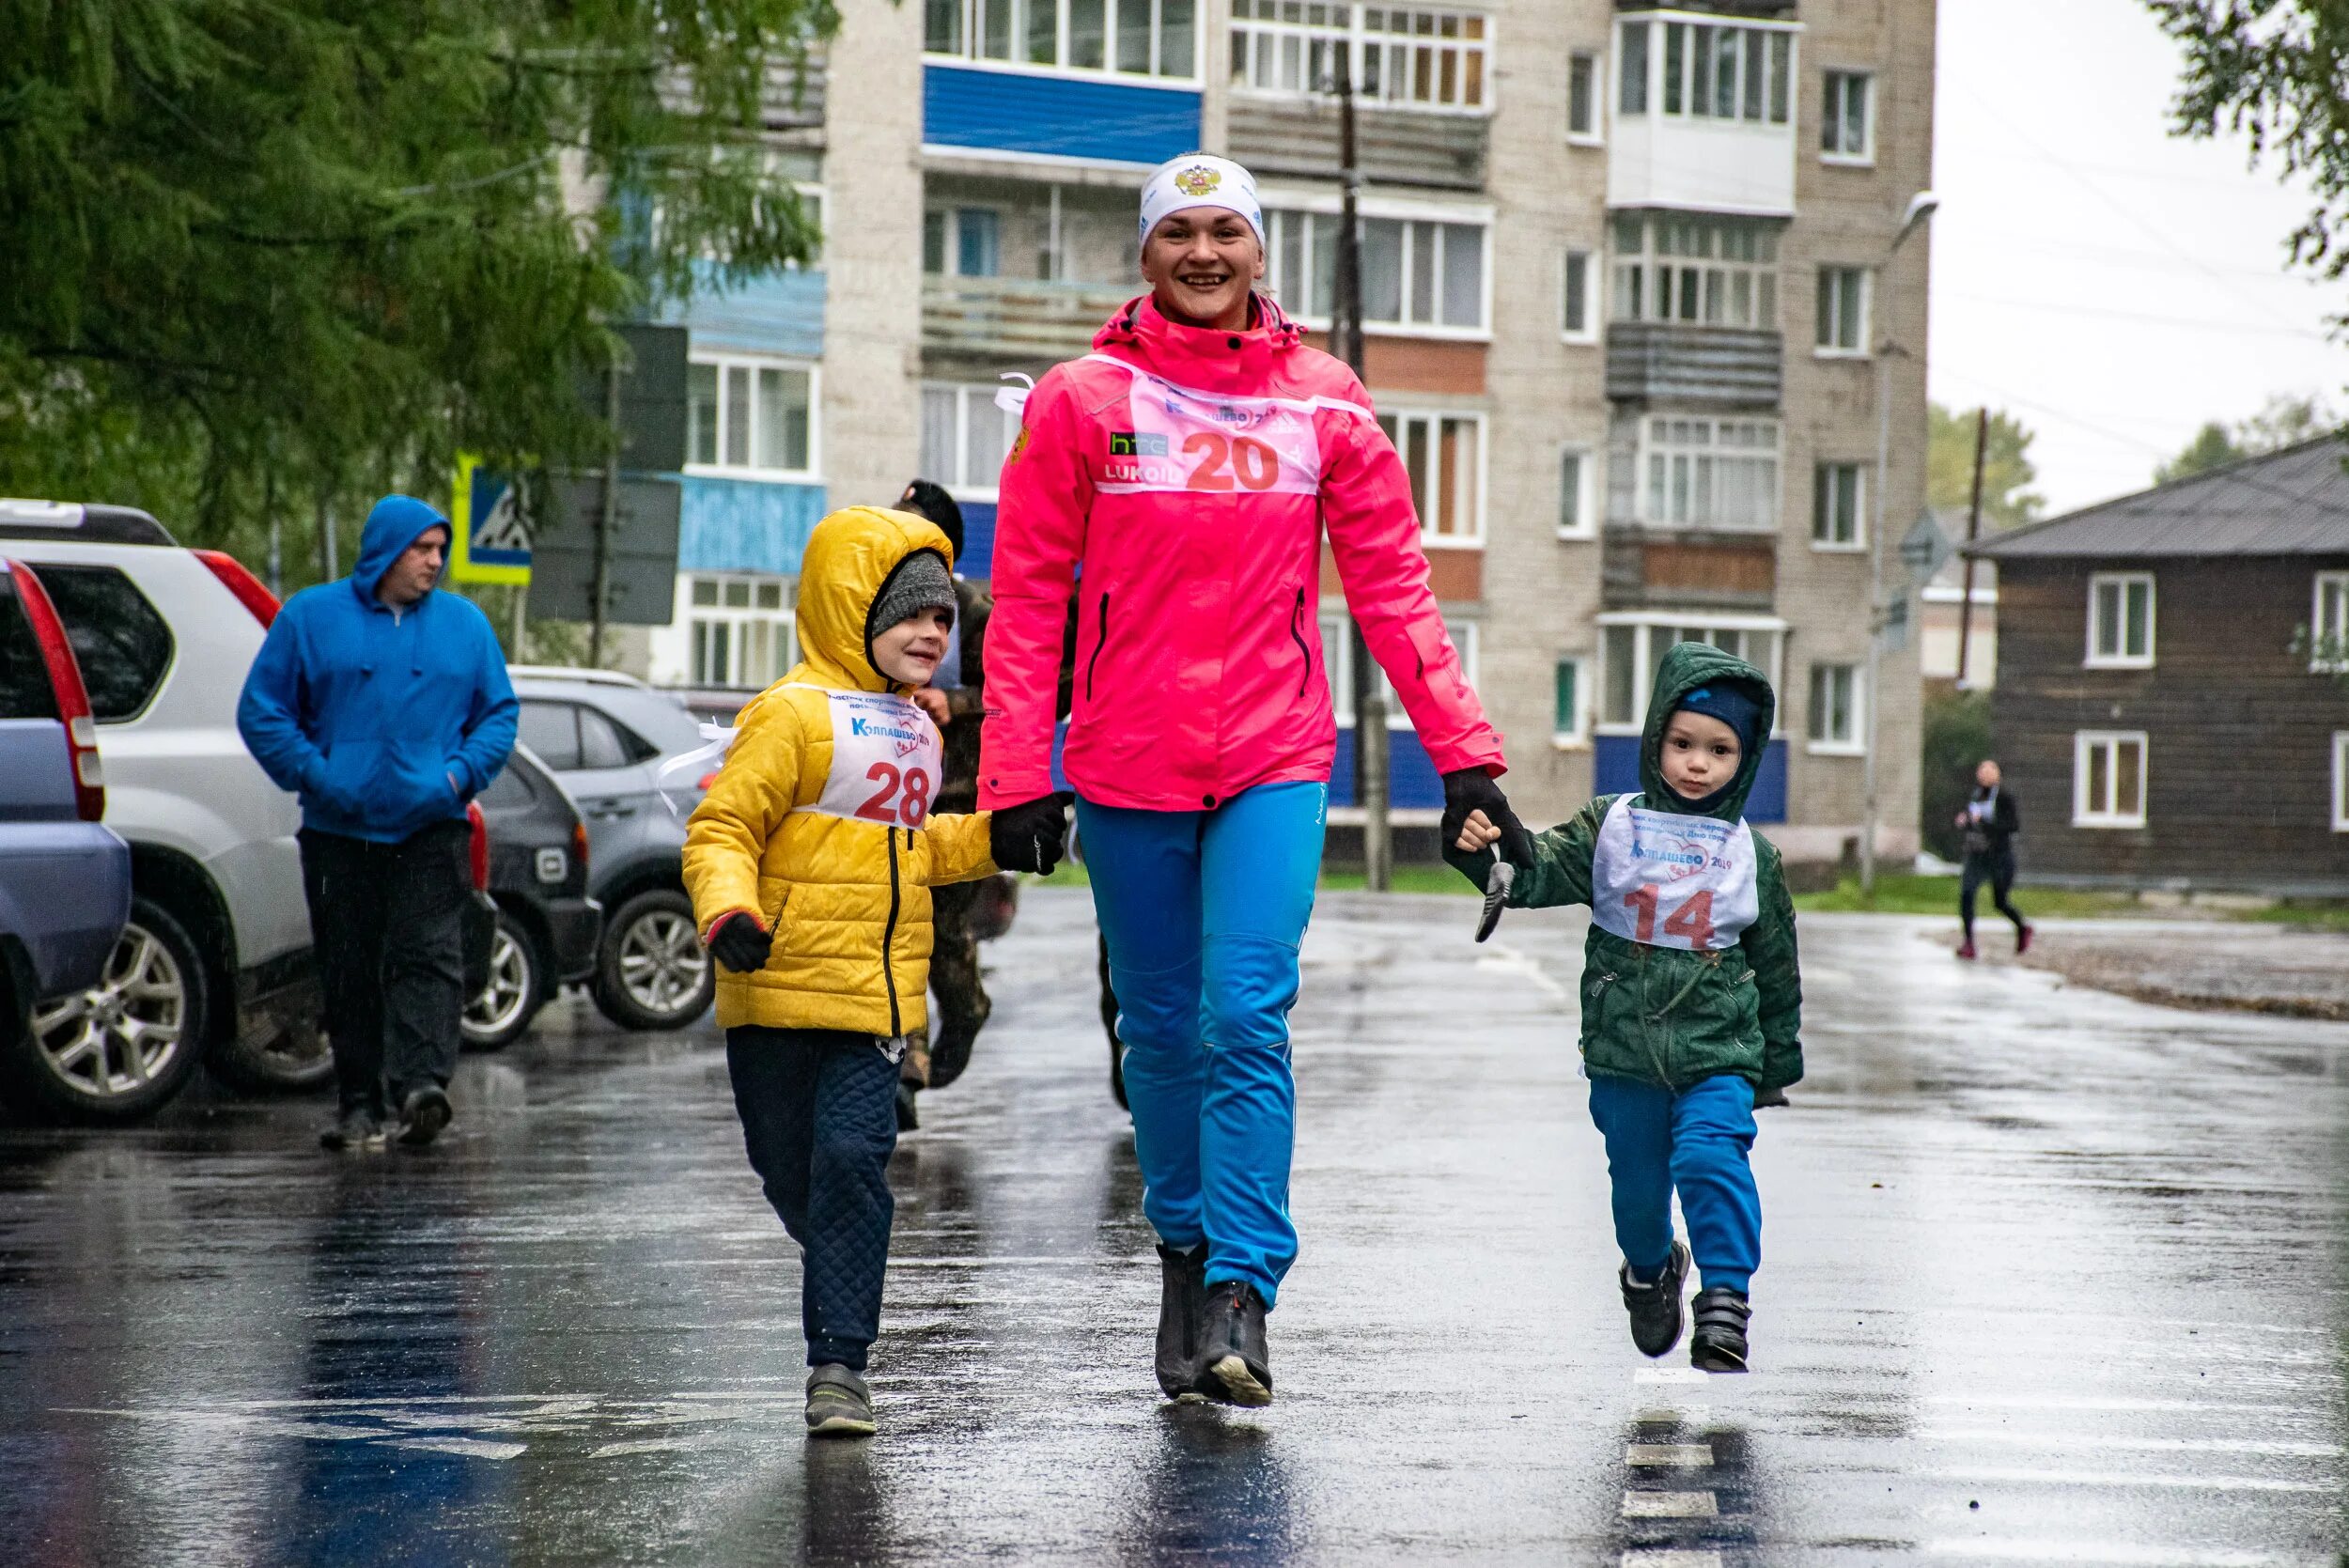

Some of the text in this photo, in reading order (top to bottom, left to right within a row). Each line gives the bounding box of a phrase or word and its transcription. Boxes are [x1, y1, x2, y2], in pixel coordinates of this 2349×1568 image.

[1182, 432, 1279, 491] 20
[854, 762, 929, 827] 28
[1711, 857, 1733, 870] 2019
[1624, 883, 1714, 949] 14
